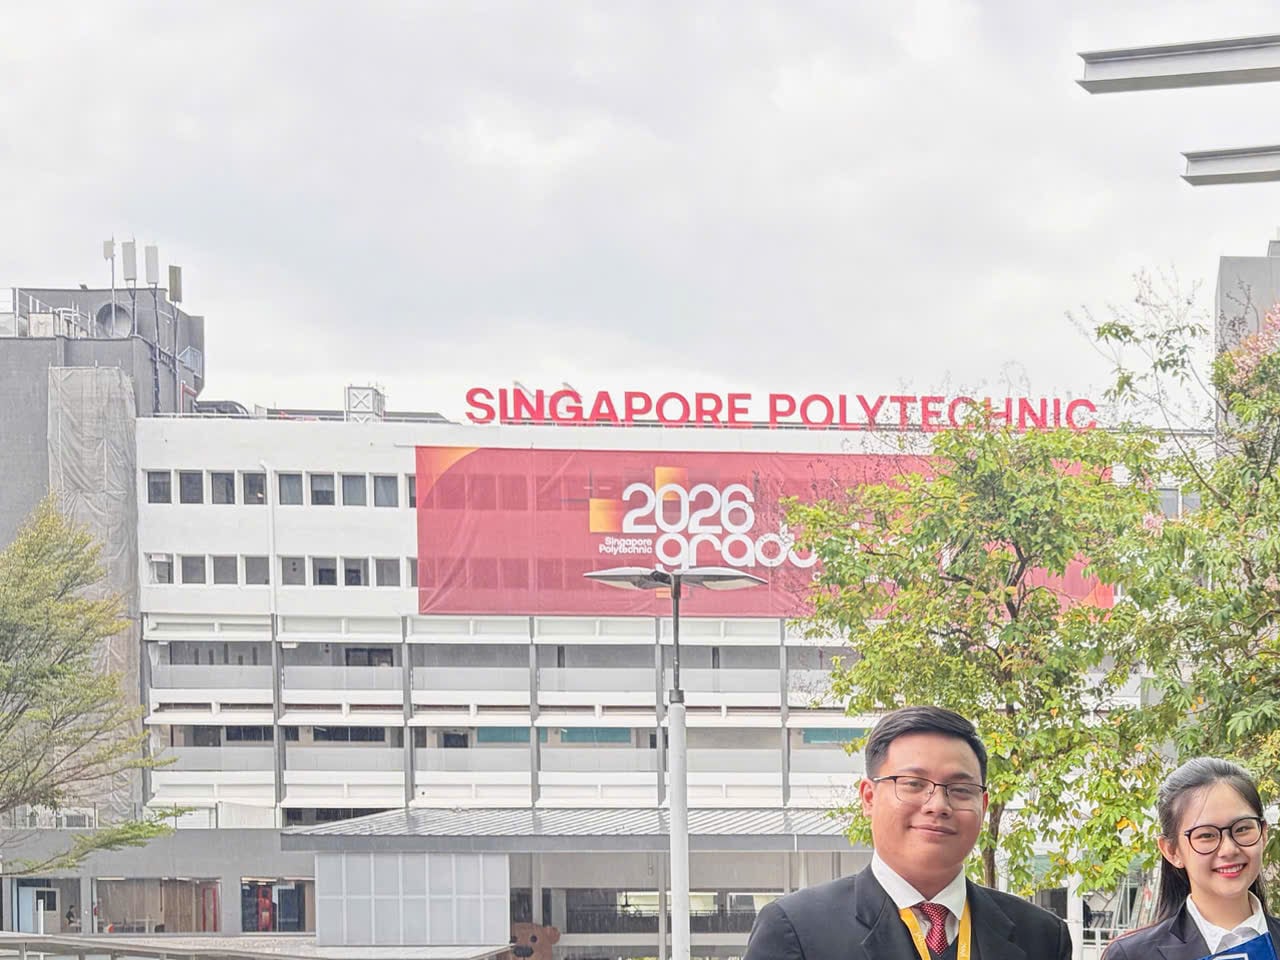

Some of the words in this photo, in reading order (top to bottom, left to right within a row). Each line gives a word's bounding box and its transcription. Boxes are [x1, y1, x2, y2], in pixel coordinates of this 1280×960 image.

[465, 387, 752, 429] SINGAPORE
[769, 392, 1098, 434] POLYTECHNIC
[622, 482, 755, 534] 2026
[599, 544, 652, 555] Polytechnic
[605, 536, 652, 547] Singapore
